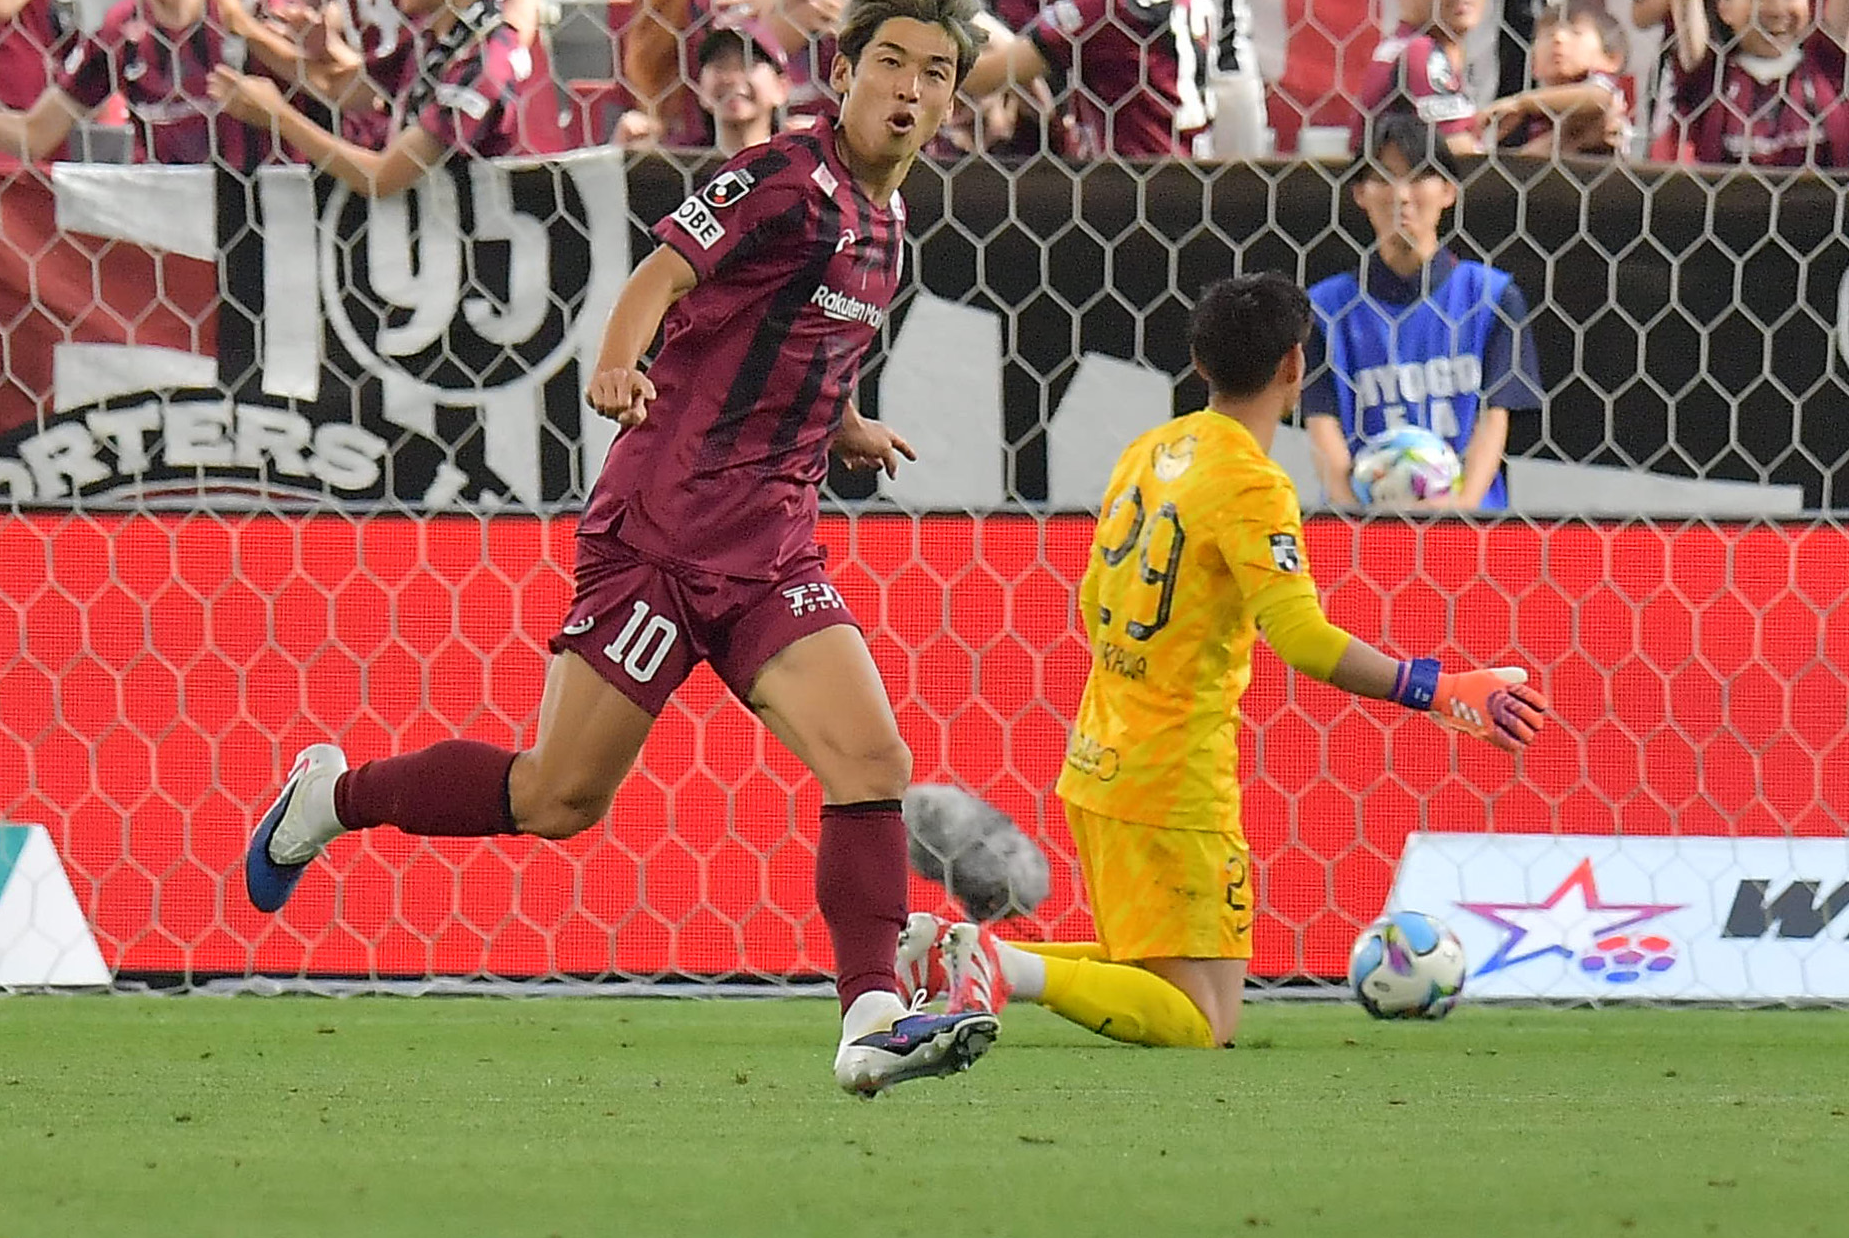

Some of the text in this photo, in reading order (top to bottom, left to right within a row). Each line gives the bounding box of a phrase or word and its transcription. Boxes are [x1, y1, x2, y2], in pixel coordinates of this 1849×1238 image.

[809, 285, 867, 322] Rakuten
[603, 600, 678, 683] 10
[1720, 878, 1849, 939] W
